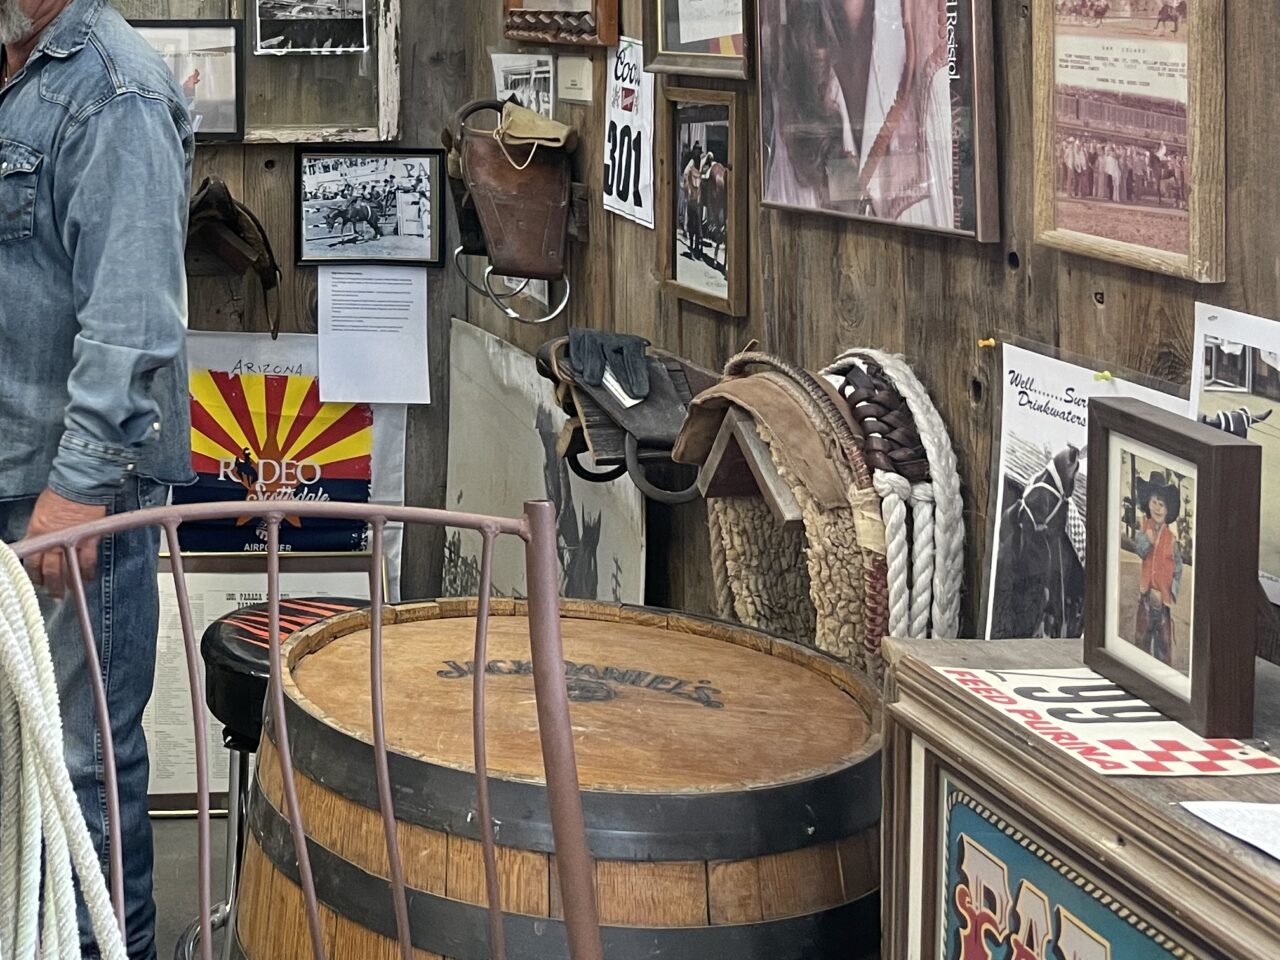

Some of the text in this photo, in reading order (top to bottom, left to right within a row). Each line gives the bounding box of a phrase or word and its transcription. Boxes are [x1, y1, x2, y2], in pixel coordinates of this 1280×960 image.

[950, 91, 960, 104] A
[604, 120, 642, 208] 301
[231, 360, 302, 376] ARIZONA
[1018, 390, 1086, 427] Drinkwaters
[217, 458, 322, 486] RDEO
[246, 482, 331, 502] Scottsdale
[244, 543, 292, 552] AIRPOER
[943, 669, 1128, 772] FEED PURINA
